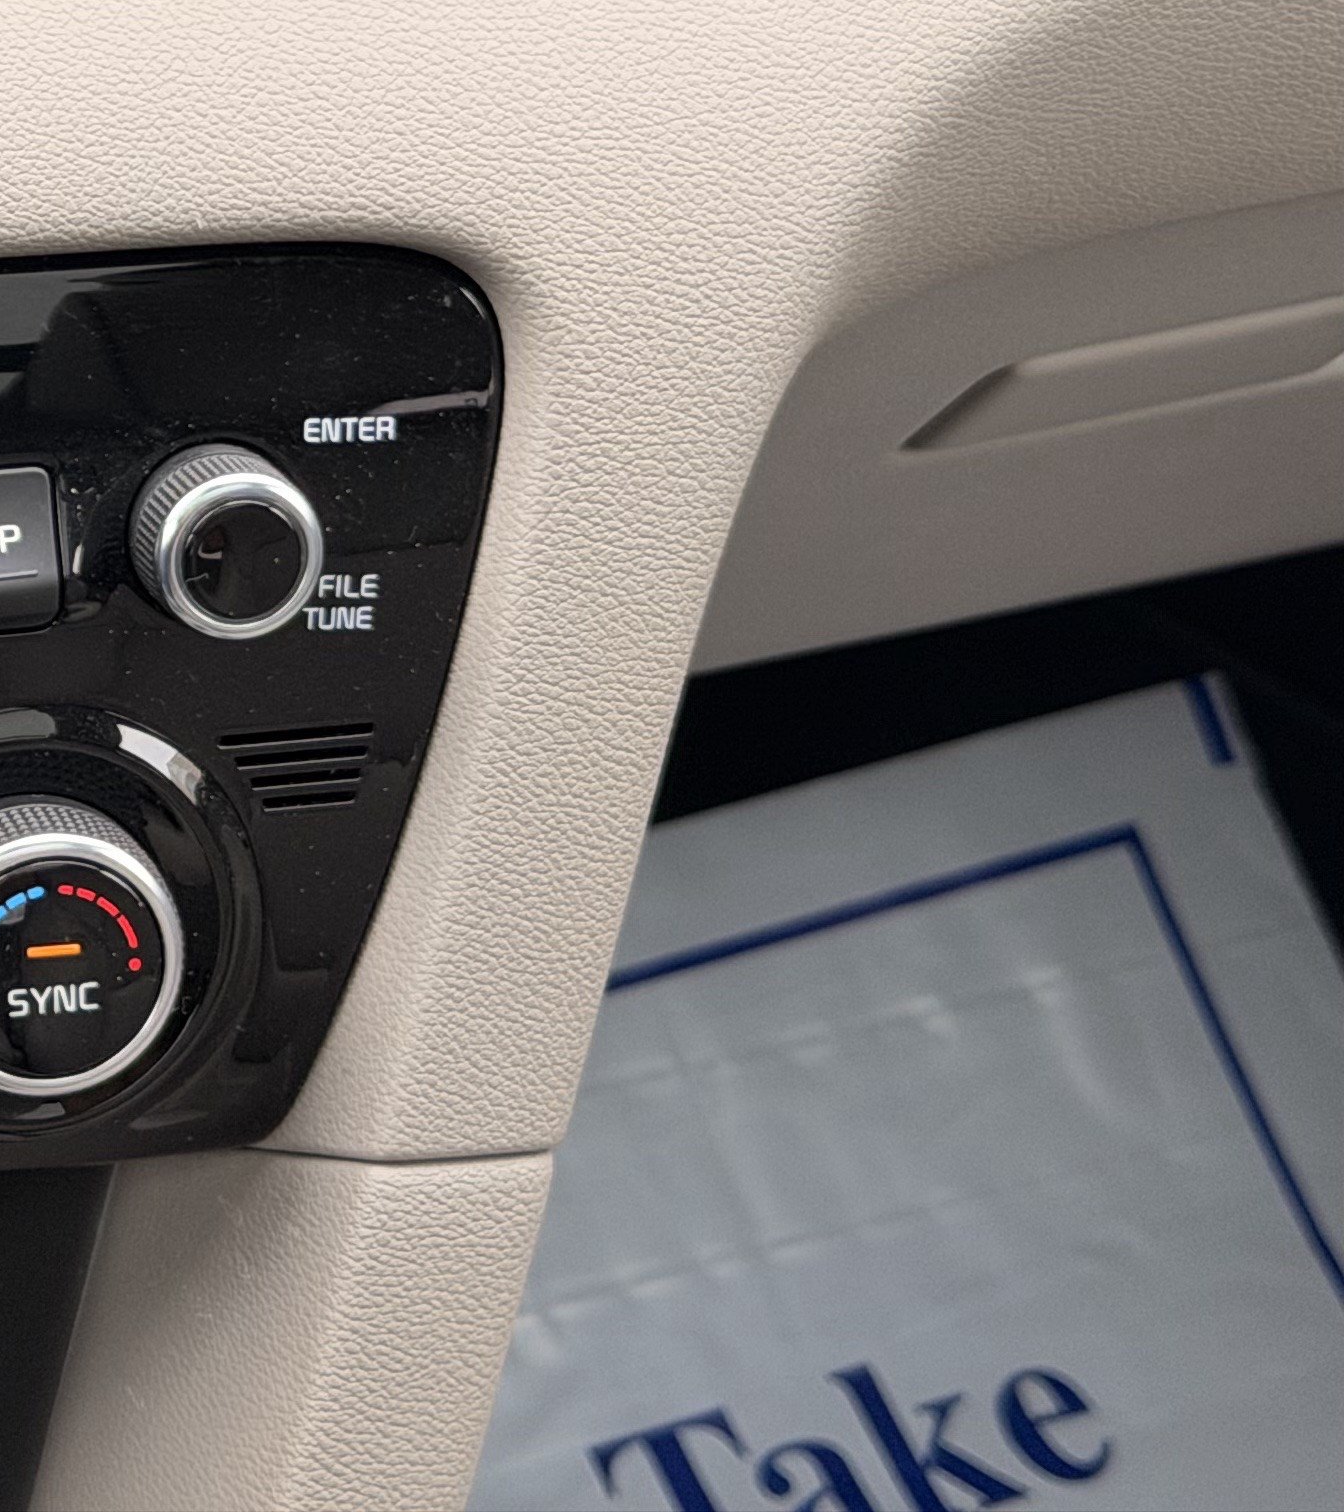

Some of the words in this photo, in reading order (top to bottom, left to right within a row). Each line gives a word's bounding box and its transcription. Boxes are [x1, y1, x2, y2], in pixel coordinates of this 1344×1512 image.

[303, 415, 397, 442] ENTER
[318, 574, 380, 598] FILE
[302, 606, 374, 631] TUNE
[7, 981, 99, 1017] SYNC
[584, 1362, 1114, 1512] Take
